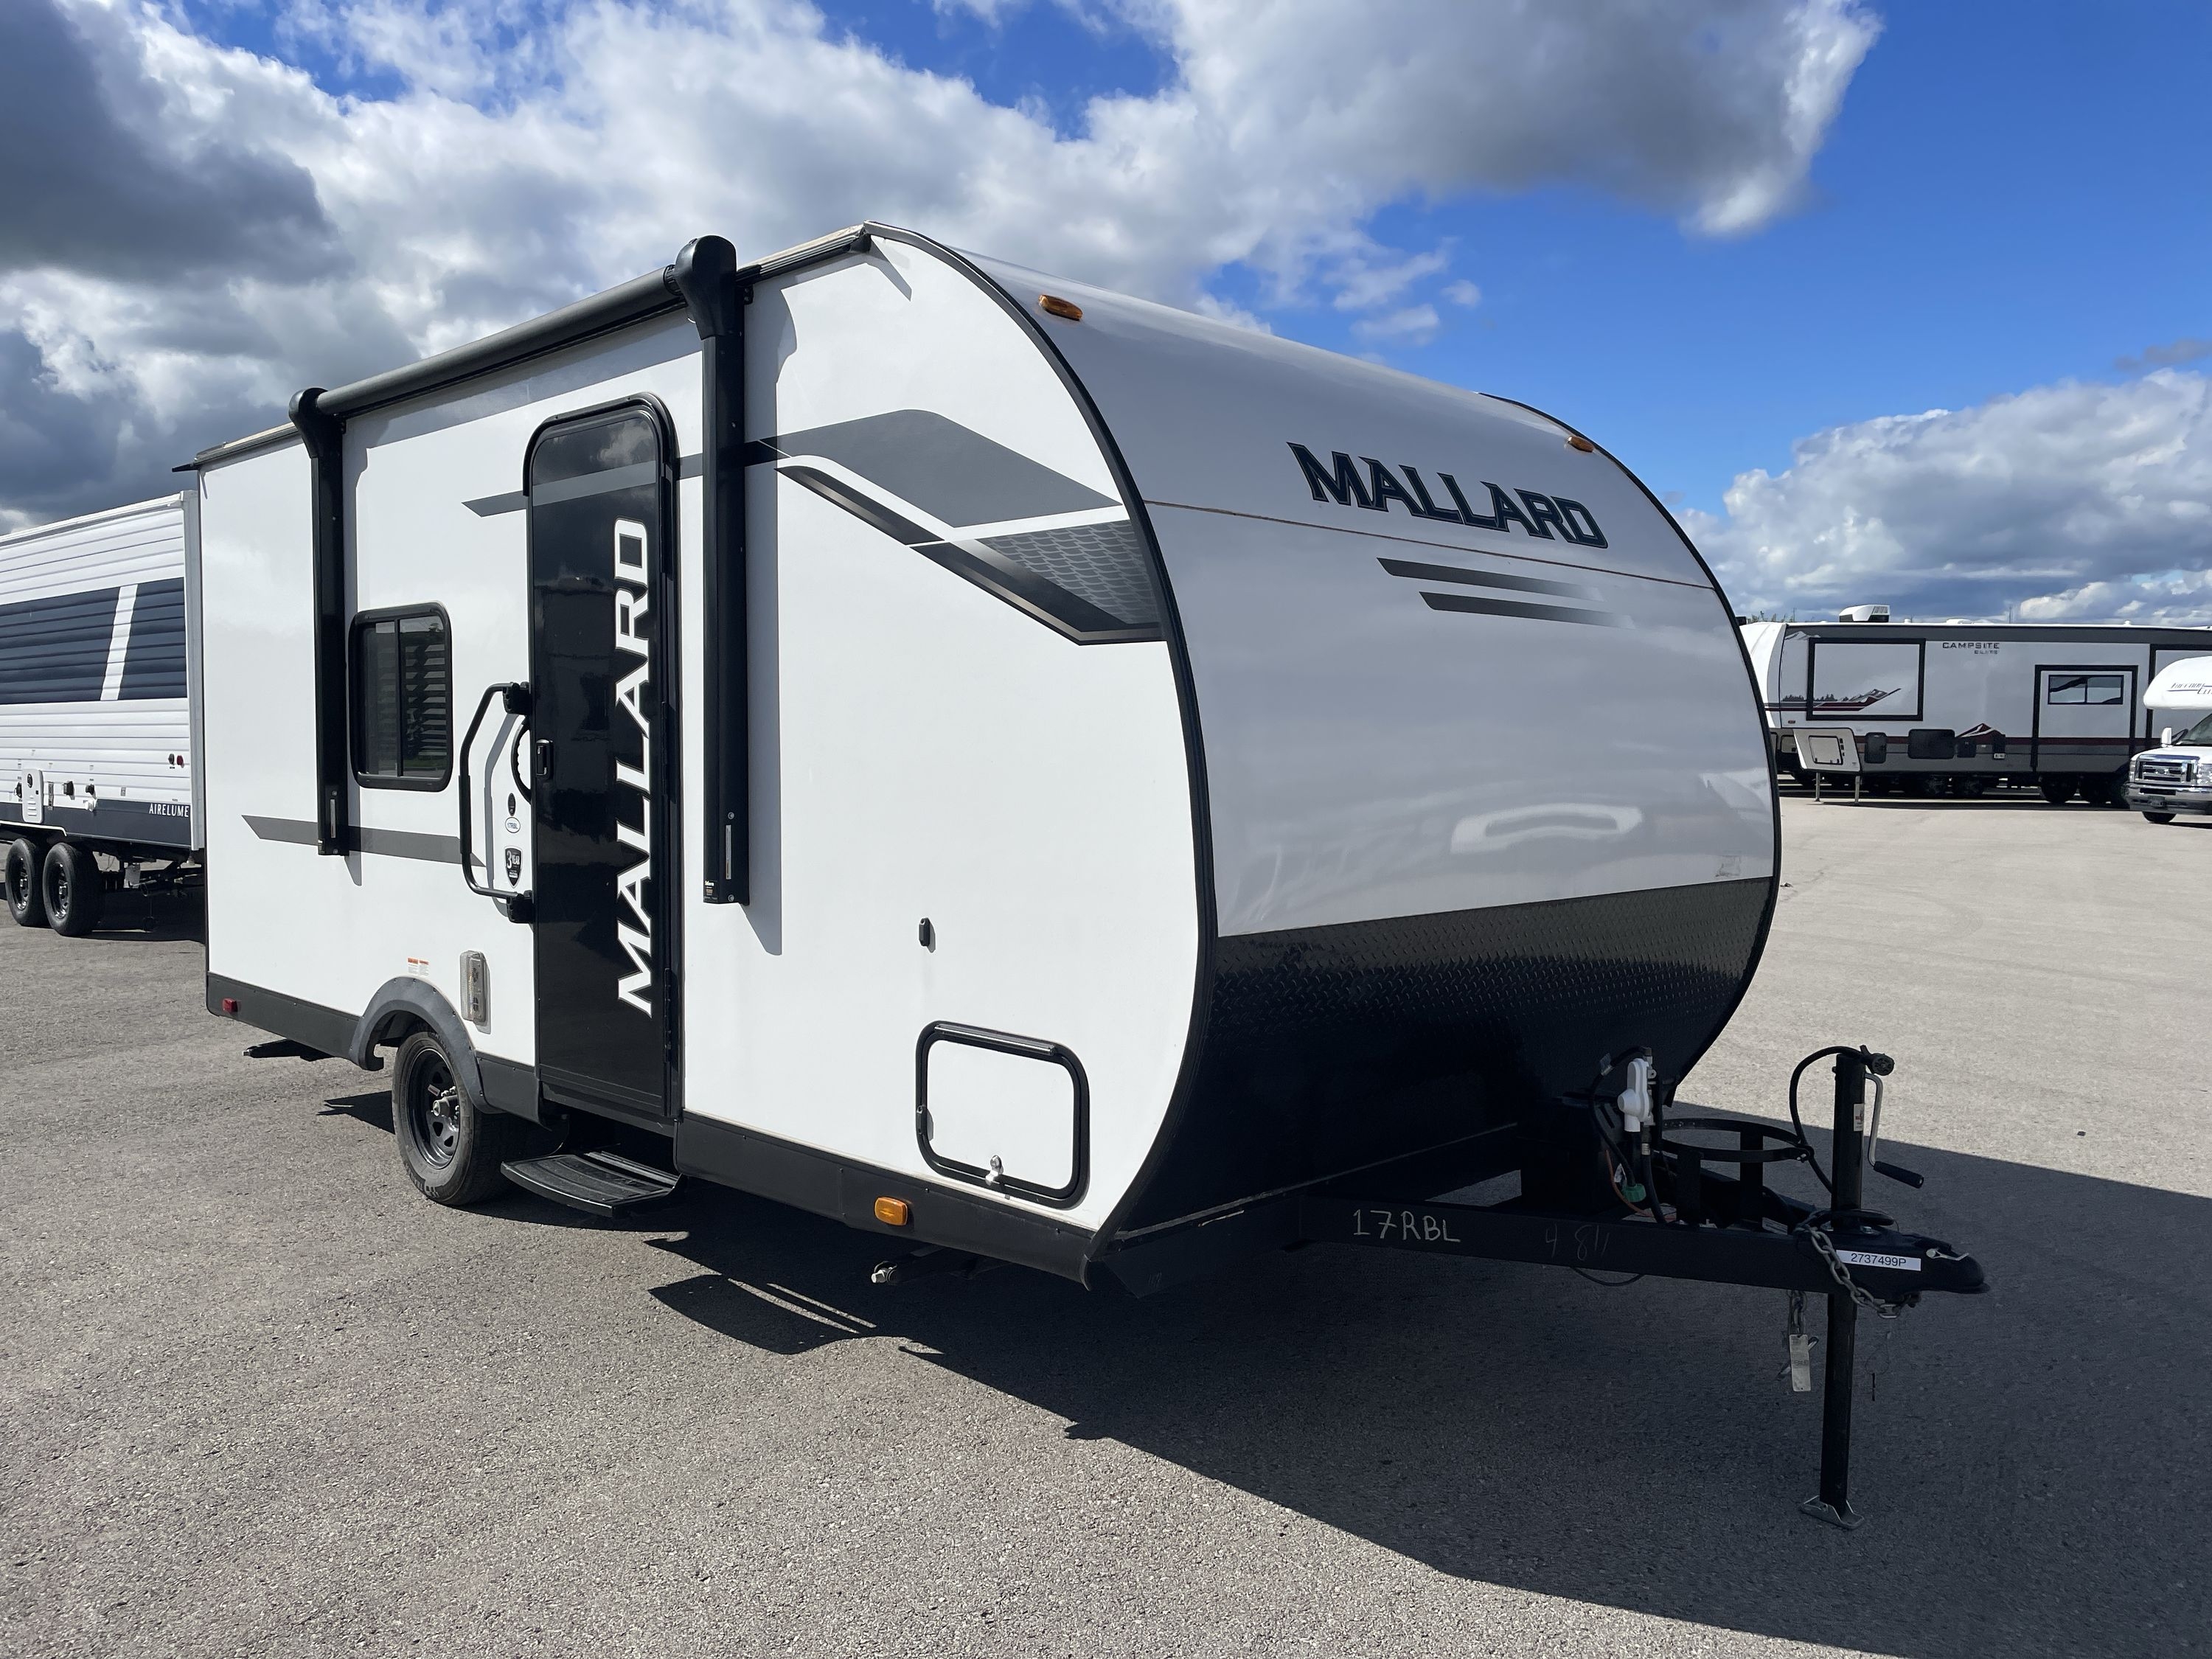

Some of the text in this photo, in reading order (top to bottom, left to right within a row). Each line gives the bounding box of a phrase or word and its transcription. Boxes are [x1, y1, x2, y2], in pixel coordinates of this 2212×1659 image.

[1286, 441, 1608, 549] MALLARD
[1942, 641, 2000, 650] CAMPSITE
[614, 517, 653, 1018] MALLARD
[148, 803, 189, 818] AIRELUME
[1353, 1208, 1461, 1242] 17RBL
[1851, 1253, 1907, 1267] 2737499P
